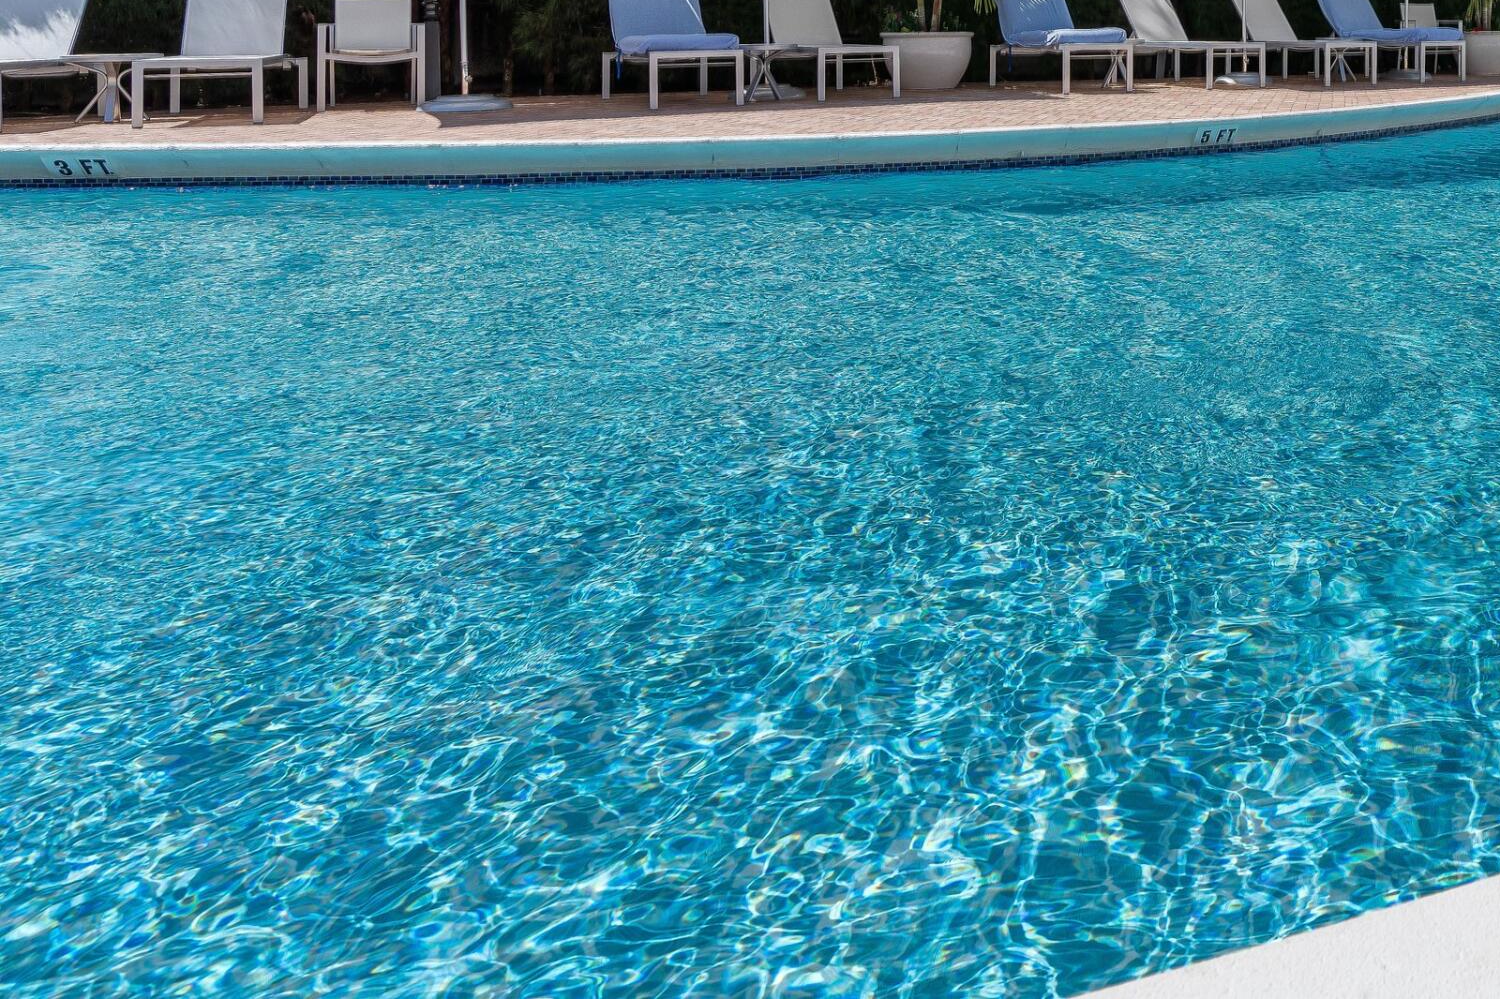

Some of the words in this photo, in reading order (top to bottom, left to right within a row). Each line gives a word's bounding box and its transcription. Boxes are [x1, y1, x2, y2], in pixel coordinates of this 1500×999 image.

[1200, 129, 1212, 143] 5
[1216, 128, 1237, 142] FT
[53, 159, 73, 176] 3
